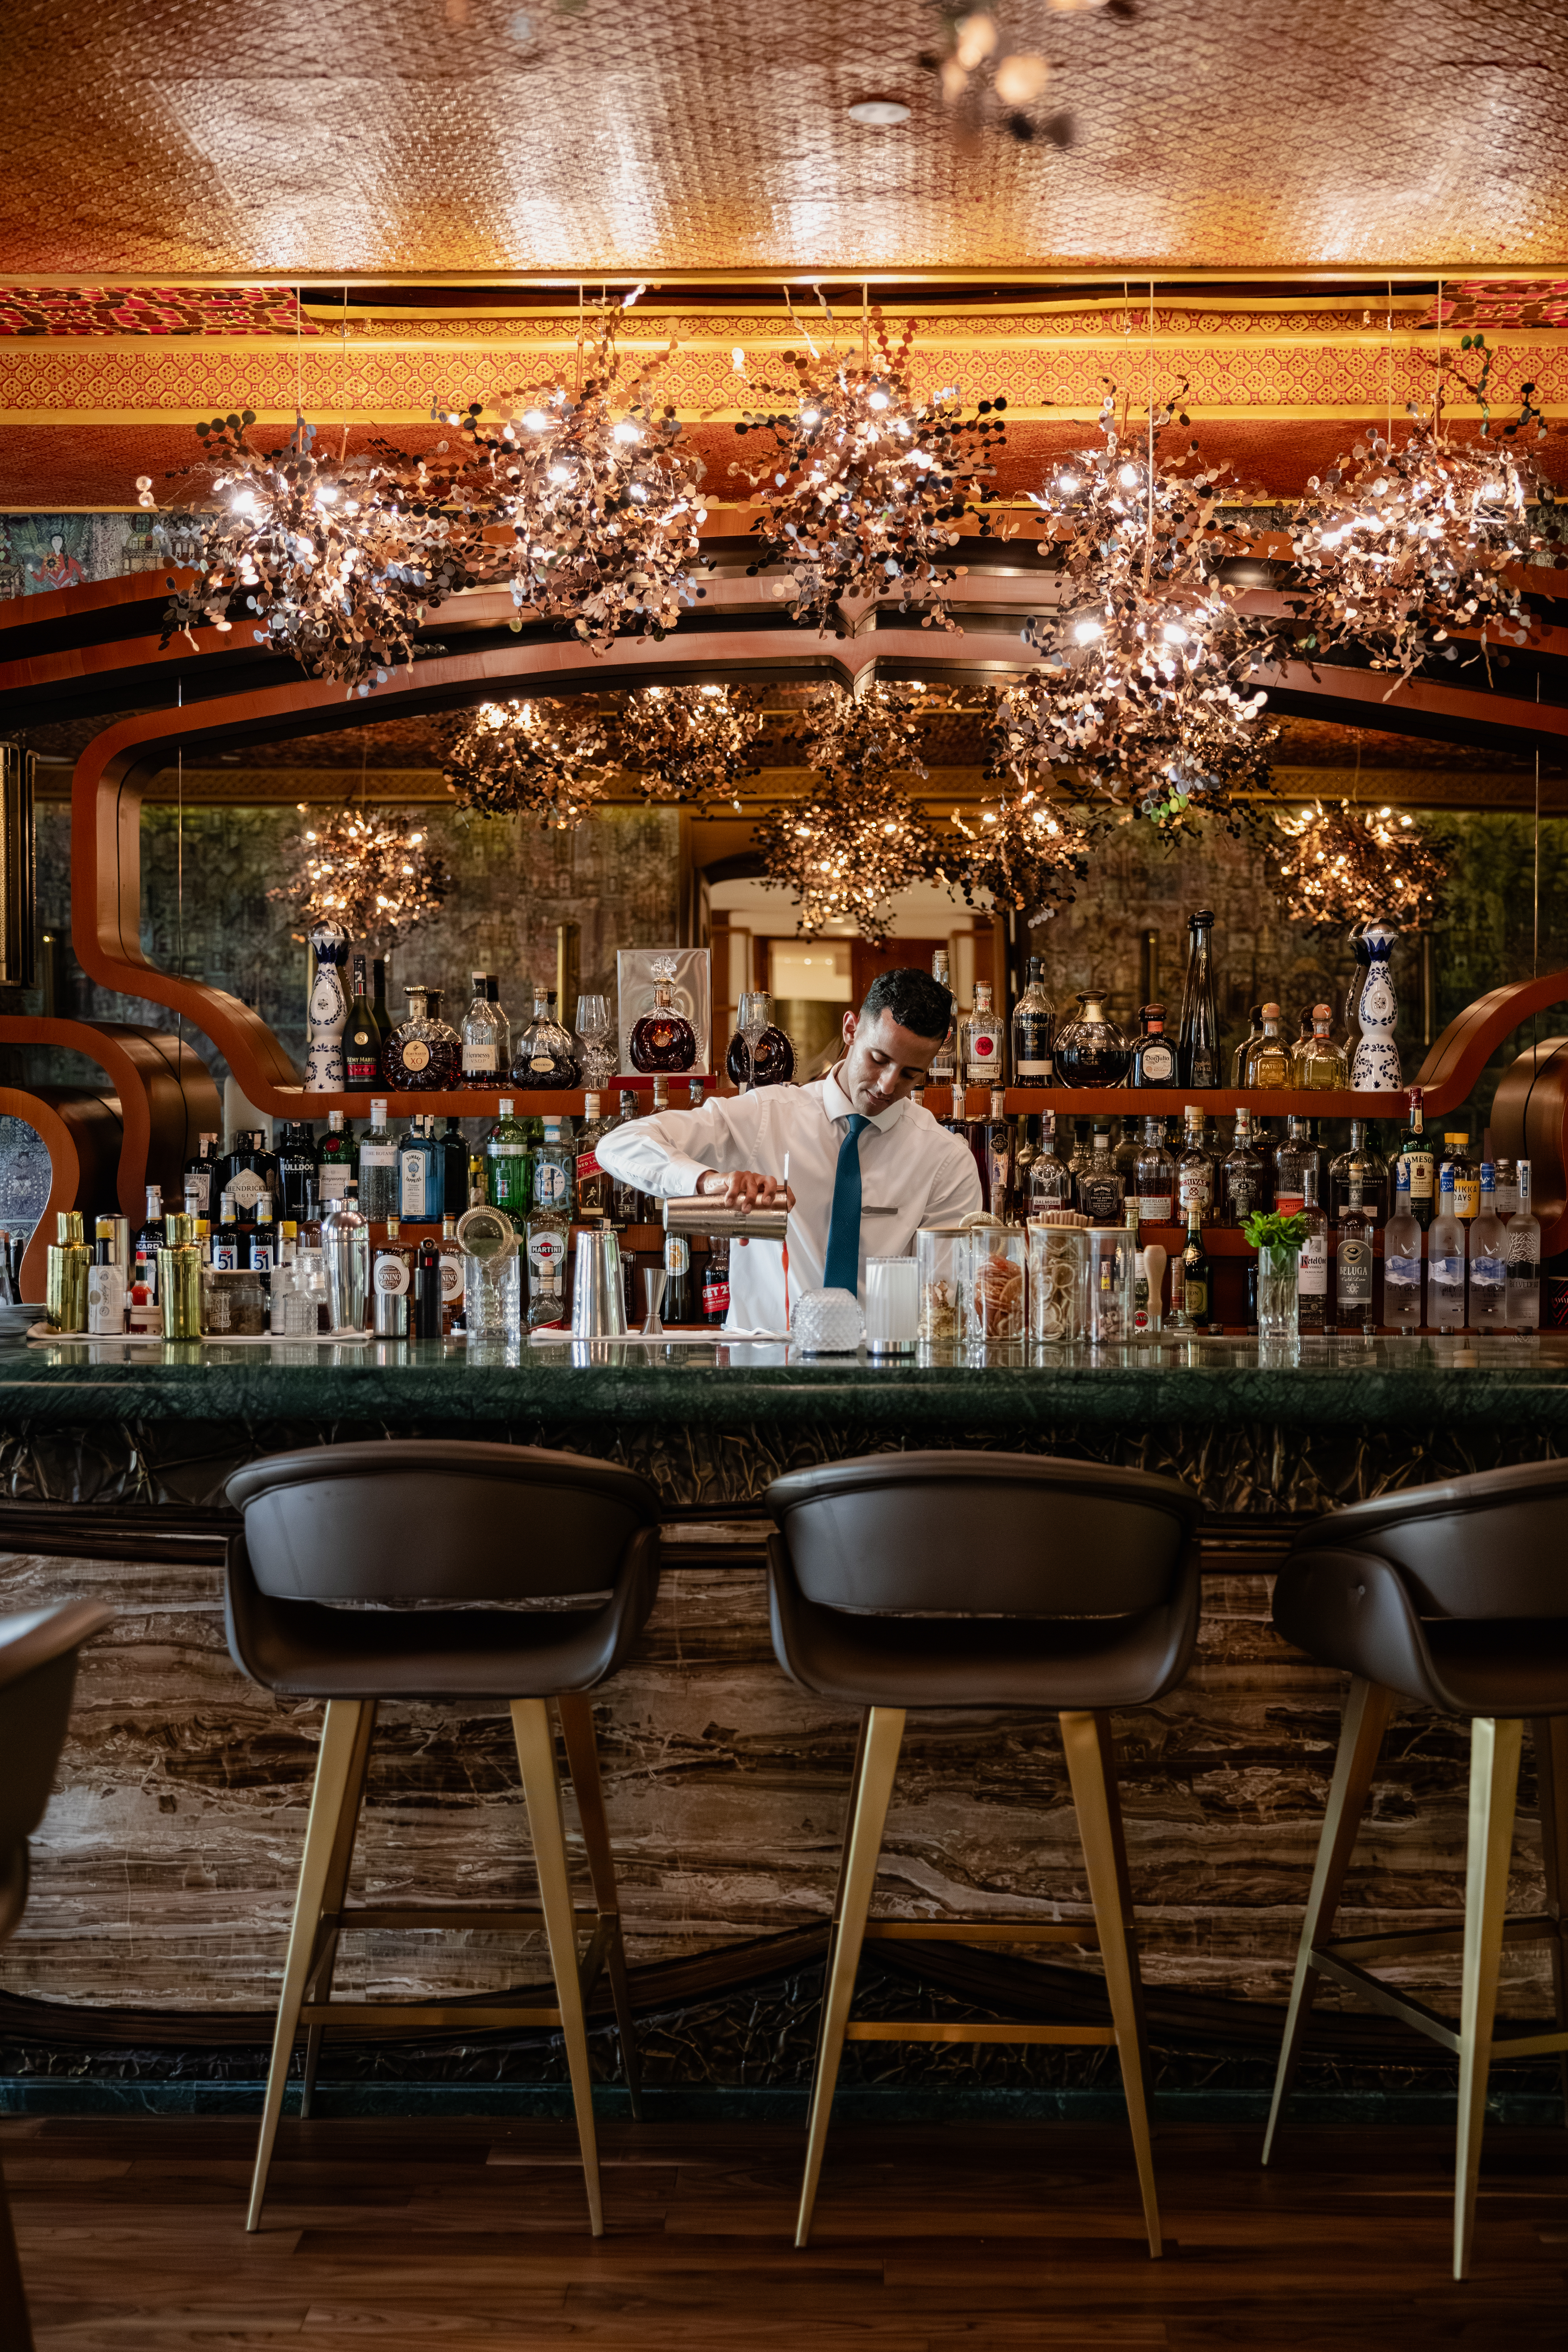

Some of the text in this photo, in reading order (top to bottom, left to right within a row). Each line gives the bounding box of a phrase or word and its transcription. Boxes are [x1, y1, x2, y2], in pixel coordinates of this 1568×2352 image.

[218, 1254, 233, 1270] 51
[254, 1254, 269, 1270] 51
[1301, 1256, 1318, 1267] Ketel
[1340, 1267, 1367, 1275] BELUGA
[702, 1284, 729, 1298] GET 2
